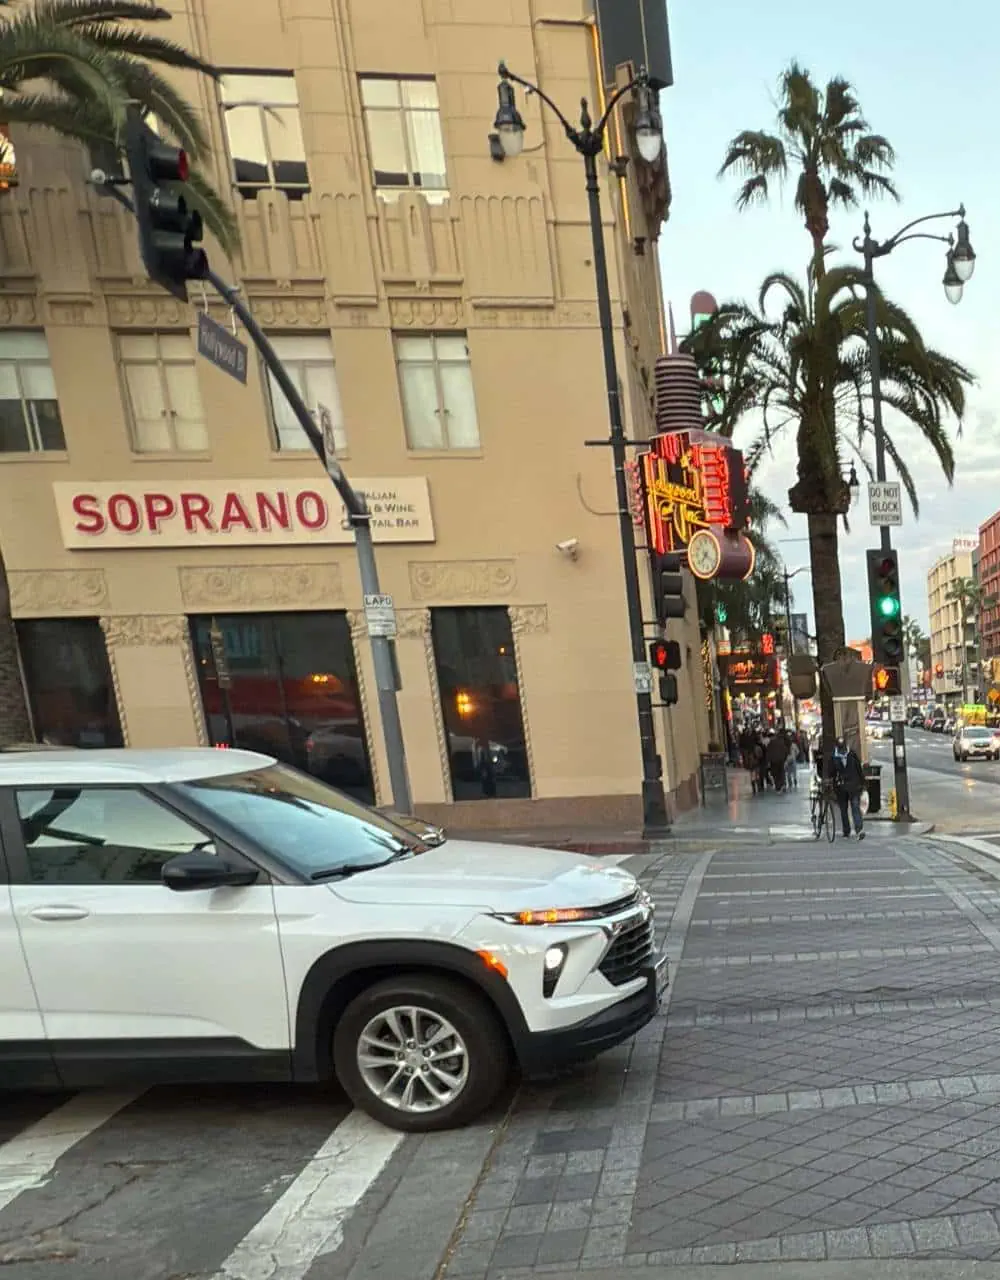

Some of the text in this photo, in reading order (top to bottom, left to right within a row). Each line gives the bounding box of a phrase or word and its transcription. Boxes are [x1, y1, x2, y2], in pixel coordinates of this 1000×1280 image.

[871, 487, 898, 497] DO NOT
[872, 501, 898, 512] BLOCK
[72, 490, 329, 535] SOPRANO
